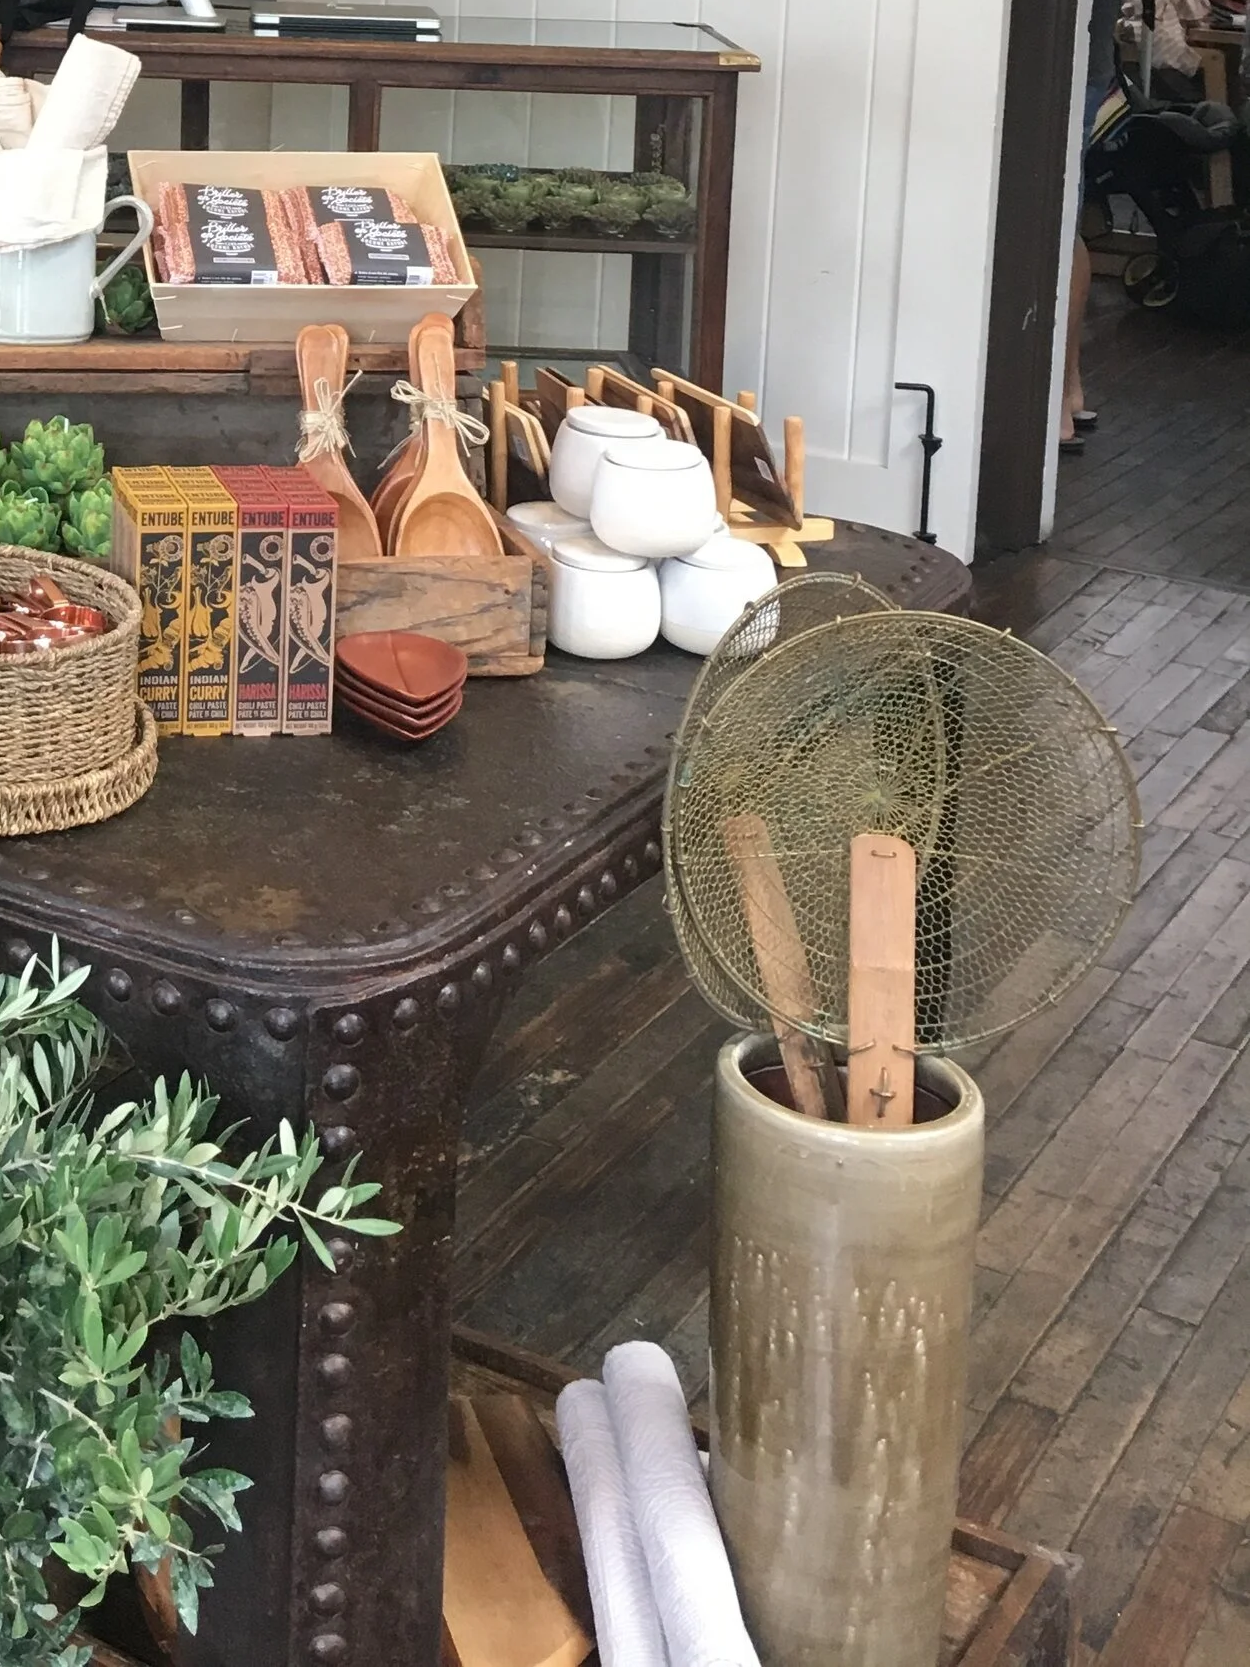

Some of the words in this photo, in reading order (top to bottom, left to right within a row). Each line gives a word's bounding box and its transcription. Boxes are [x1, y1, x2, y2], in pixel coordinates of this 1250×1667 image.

[141, 512, 184, 527] ENTUBE
[191, 511, 235, 526] ENTUBE
[242, 512, 286, 527] ENTUBE
[292, 512, 334, 527] ENTUBE
[140, 675, 178, 685] INDIAN
[190, 675, 228, 684] INDIAN
[139, 686, 178, 701] CURRY
[190, 686, 228, 701] CURRY
[238, 683, 276, 701] HARISSA
[289, 683, 327, 701] HARISSA
[157, 701, 177, 710] PASTE
[189, 702, 206, 710] CHILI
[207, 701, 226, 710] PASTE
[238, 702, 255, 710] CHILI
[256, 701, 276, 710] PASTE
[288, 702, 305, 710] CHILI
[306, 701, 326, 710] PASTE
[161, 710, 178, 719] CHILI
[211, 710, 227, 718] CHILI
[260, 710, 276, 718] CHILI
[310, 710, 326, 718] CHILI
